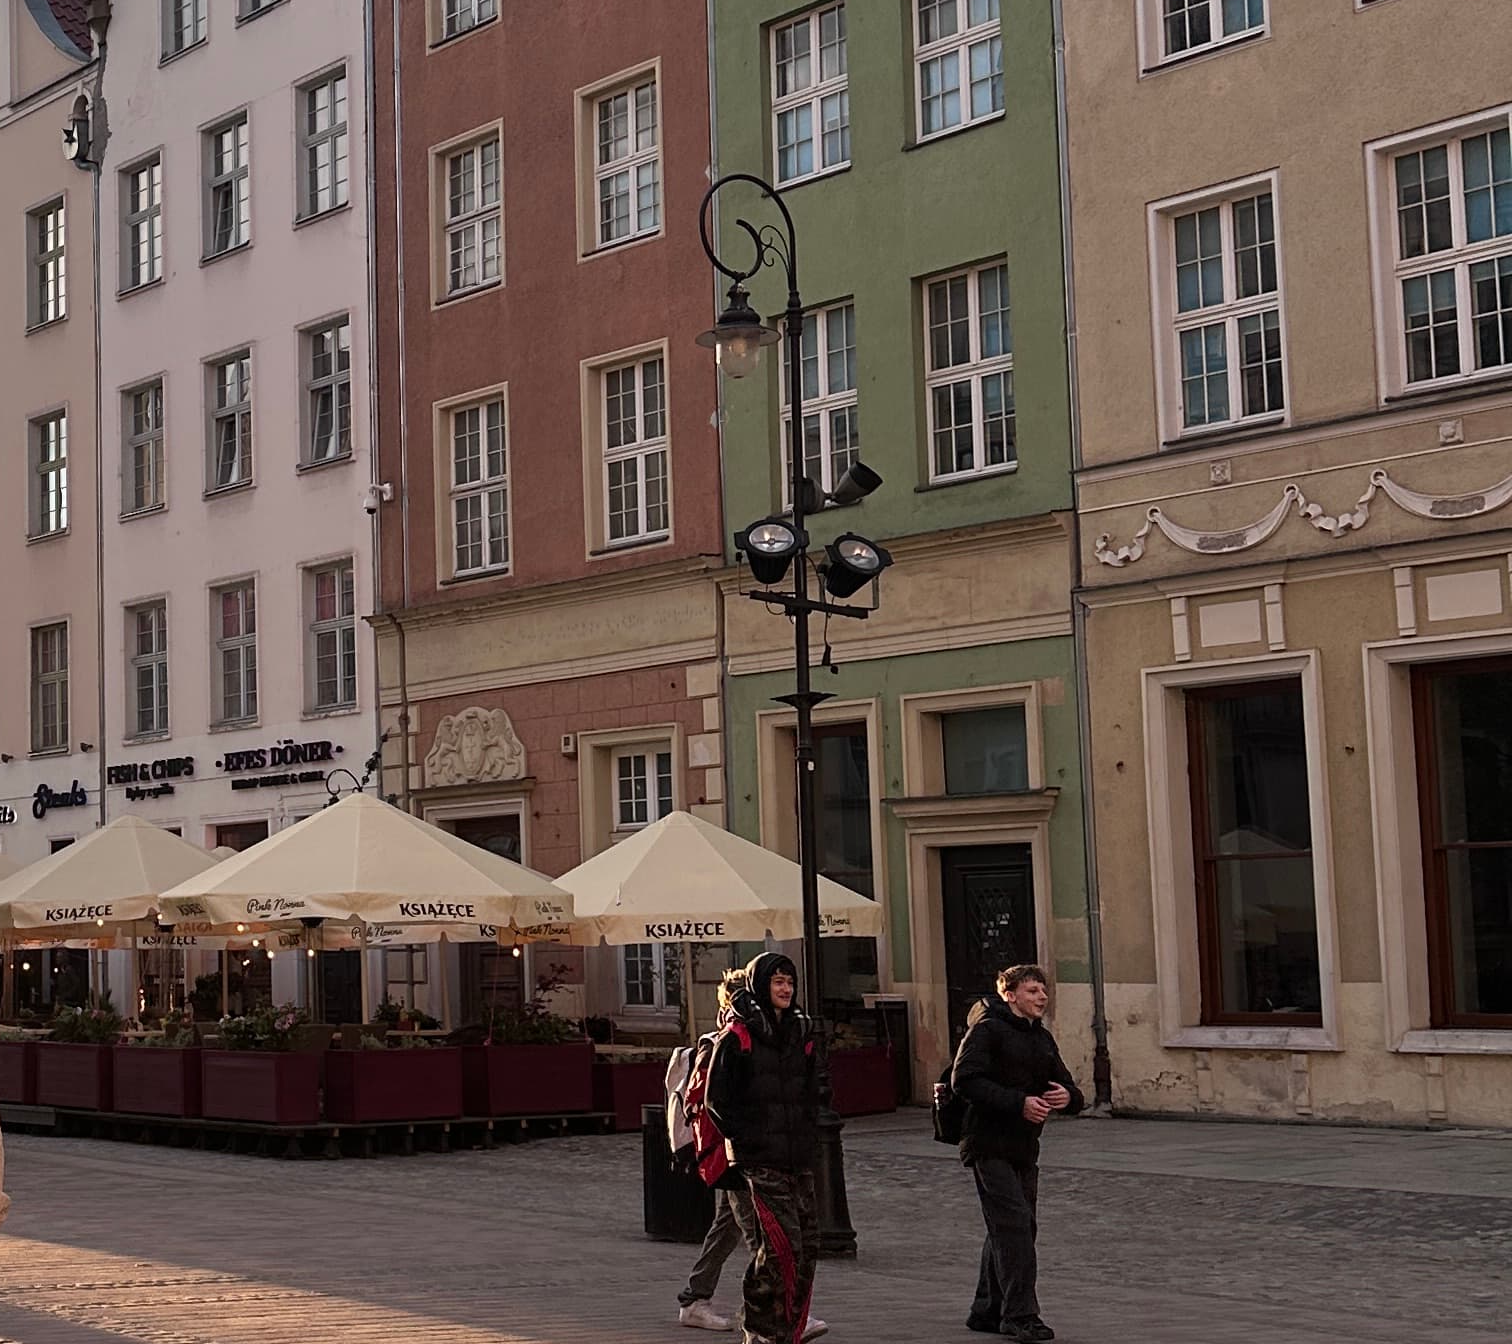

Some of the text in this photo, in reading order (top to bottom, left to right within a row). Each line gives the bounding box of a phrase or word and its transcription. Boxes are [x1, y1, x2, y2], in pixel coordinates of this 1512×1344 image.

[138, 763, 151, 781] &
[151, 756, 195, 778] CHIPS
[45, 904, 113, 922] KSIĄŻĘCE
[399, 900, 476, 919] KSIĄŻĘCE
[645, 919, 725, 940] KSIĄŻĘCE
